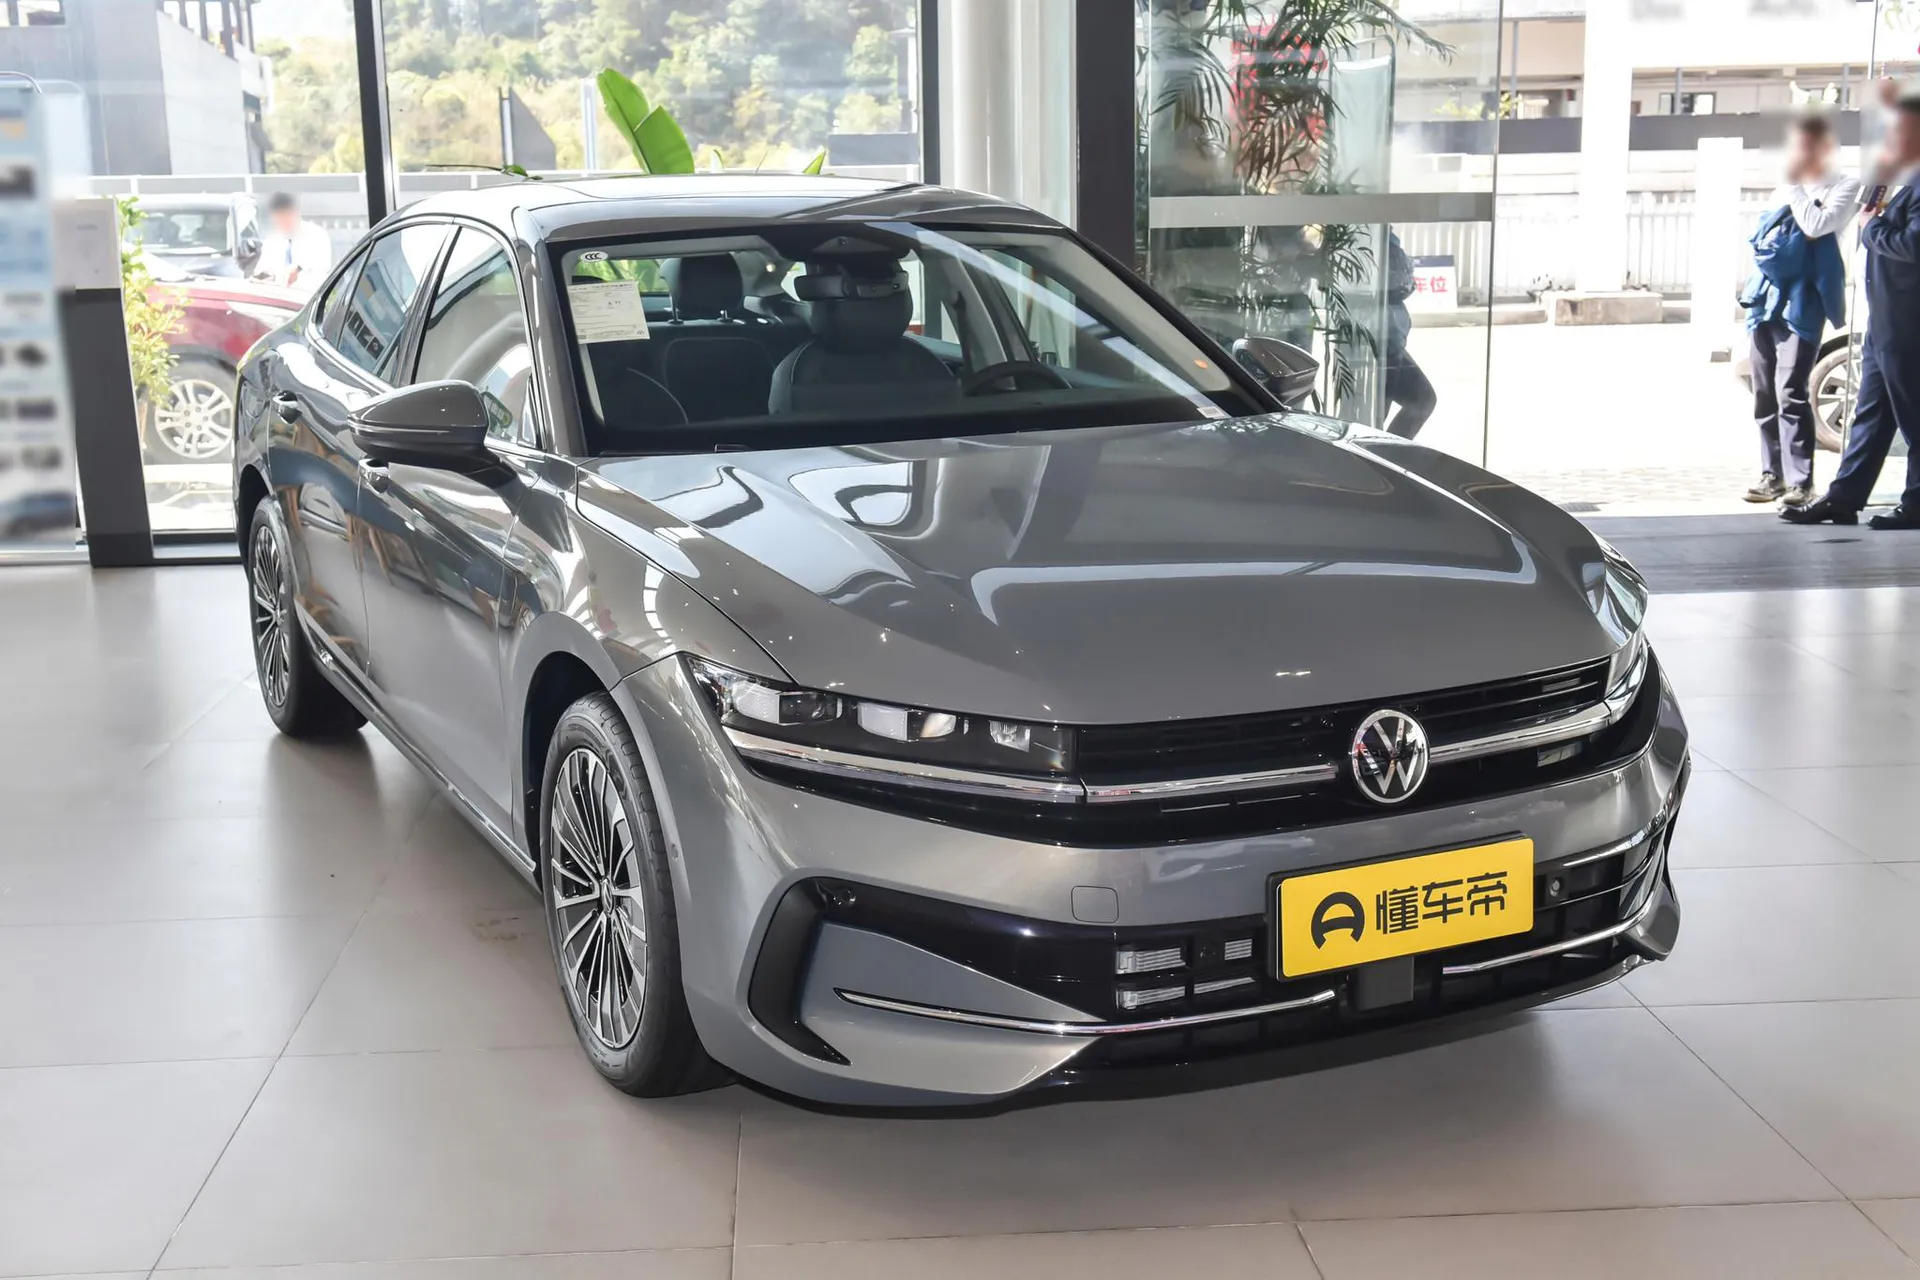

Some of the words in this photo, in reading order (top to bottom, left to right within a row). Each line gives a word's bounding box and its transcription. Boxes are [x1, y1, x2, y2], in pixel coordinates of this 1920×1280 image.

[584, 252, 603, 261] CCC
[1356, 715, 1422, 797] VW
[1375, 871, 1508, 934] 懂车帝
